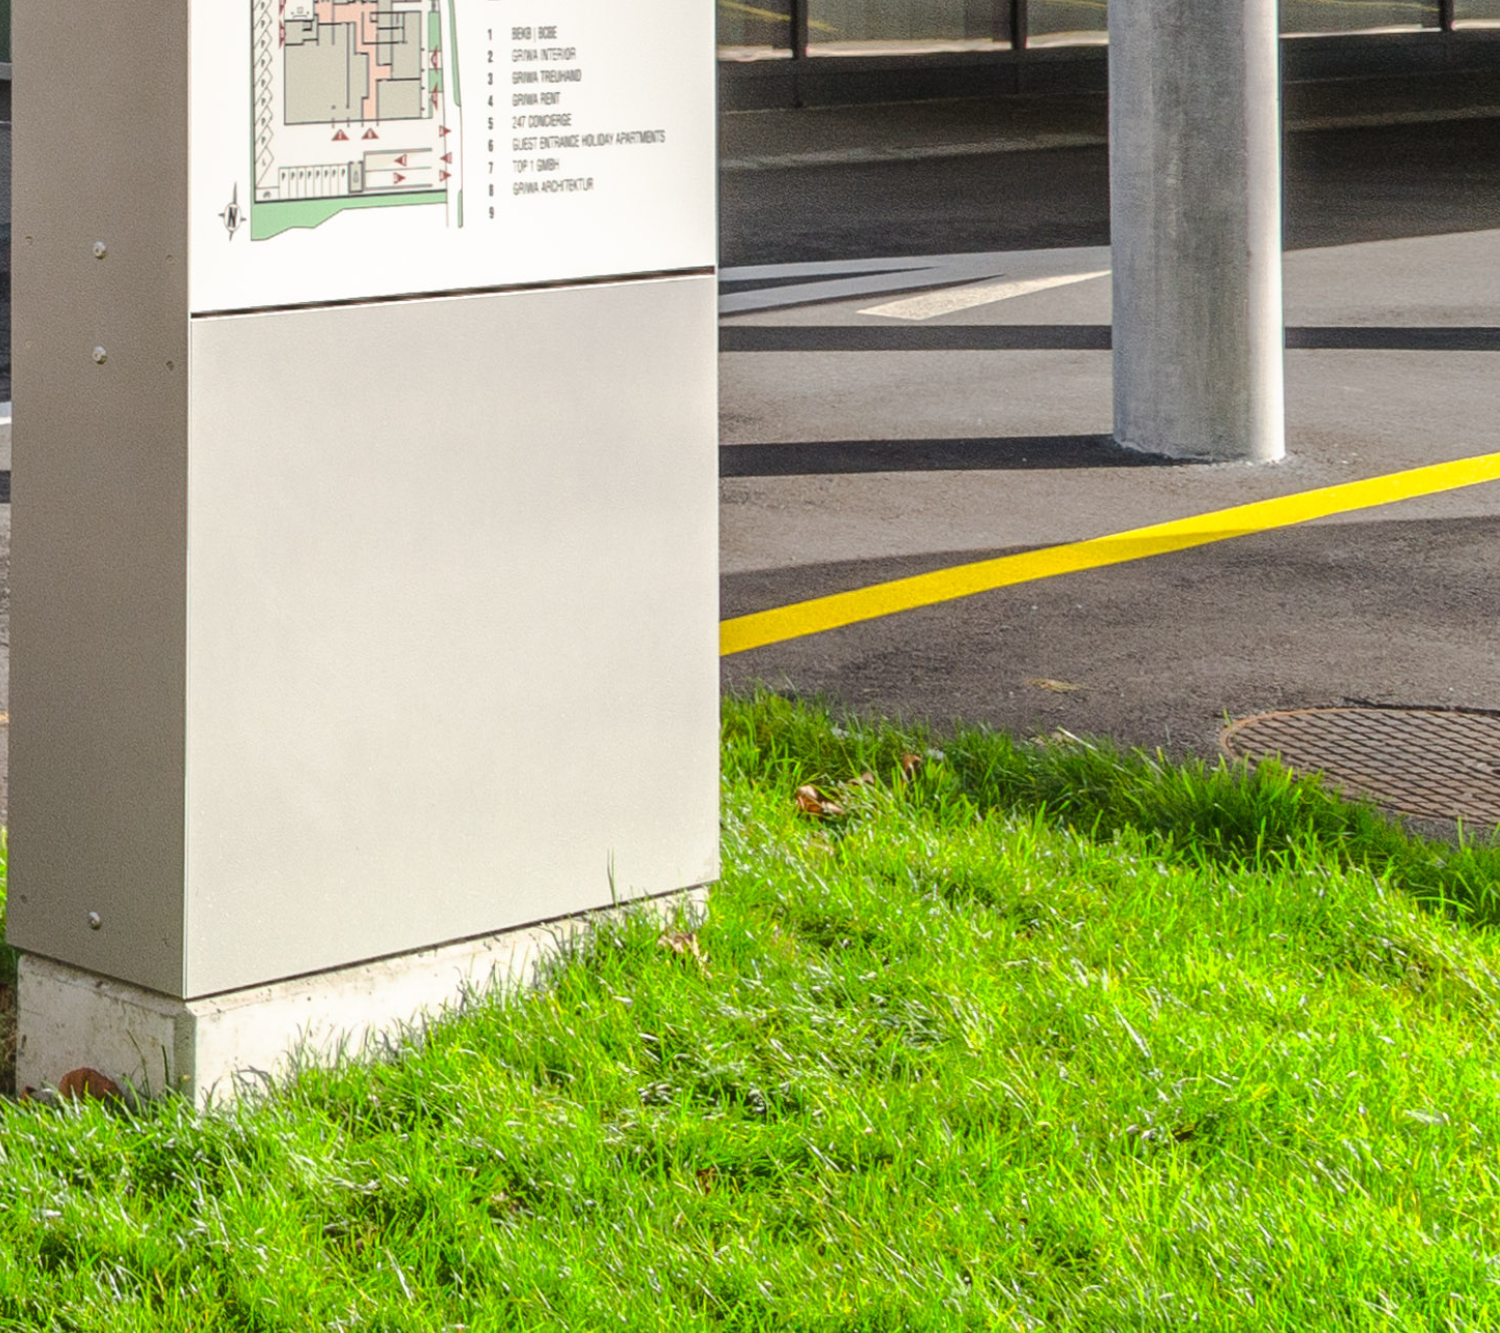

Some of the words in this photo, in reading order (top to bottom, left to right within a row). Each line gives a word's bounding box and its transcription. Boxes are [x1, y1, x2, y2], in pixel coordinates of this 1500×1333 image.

[488, 29, 492, 41] 1
[488, 50, 493, 63] 2
[488, 73, 493, 85] 3
[488, 117, 493, 130] 5
[582, 133, 614, 146] HOLIDAY
[513, 160, 528, 173] TOP
[228, 206, 238, 229] N
